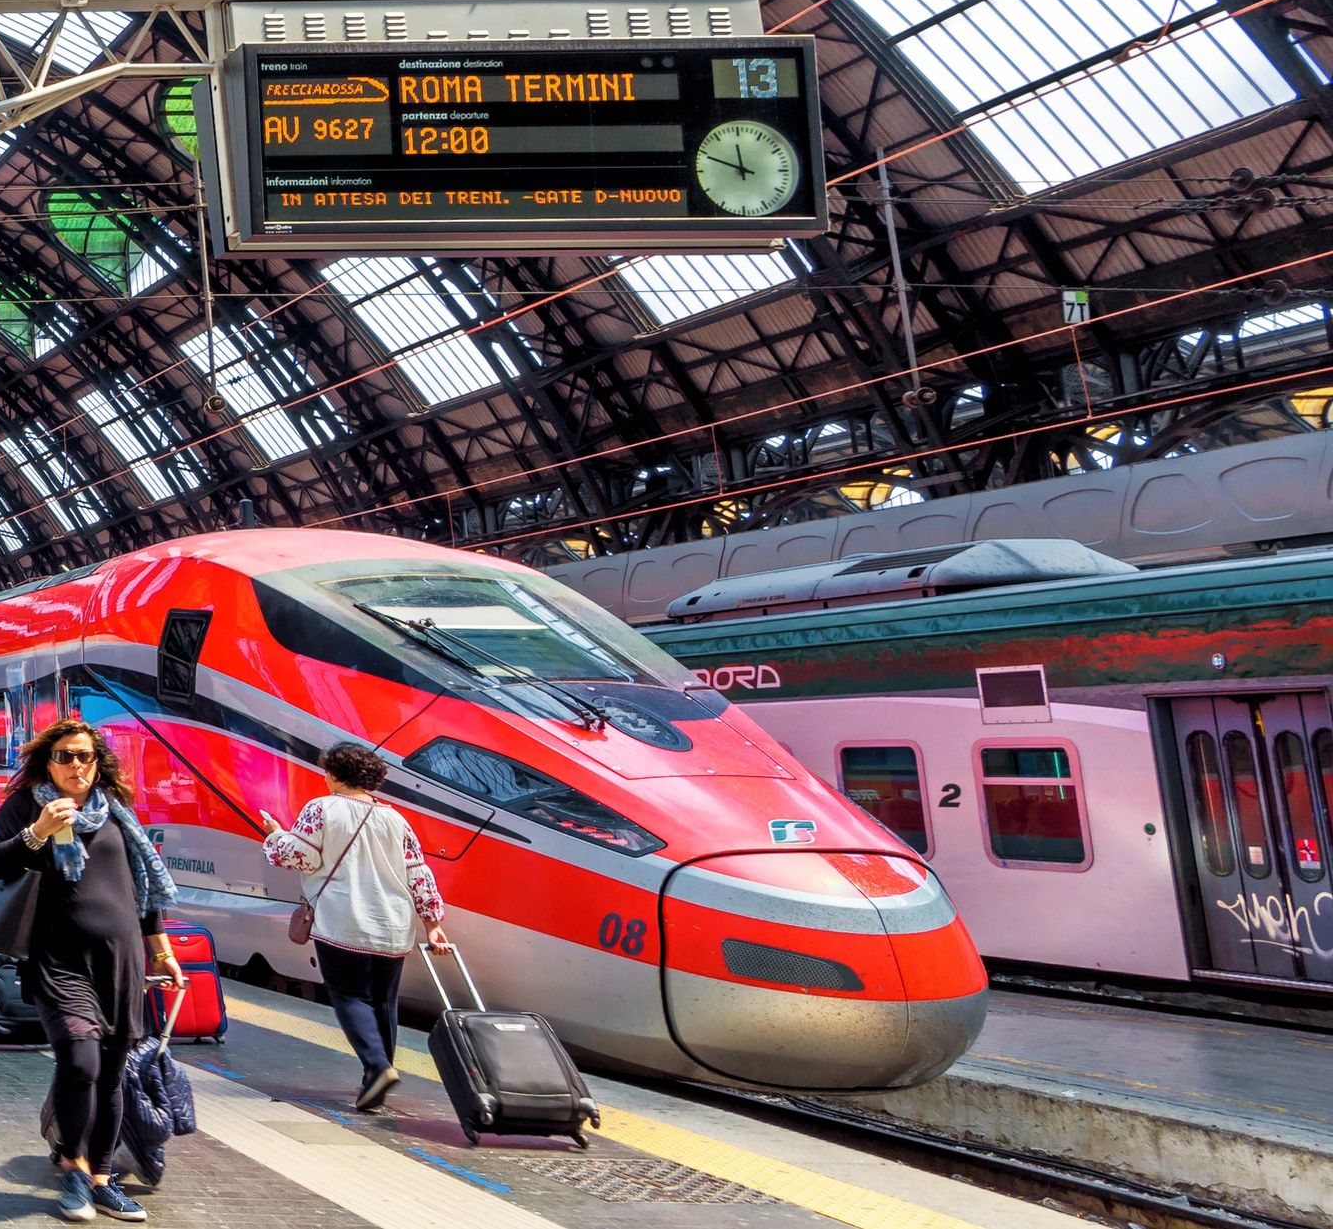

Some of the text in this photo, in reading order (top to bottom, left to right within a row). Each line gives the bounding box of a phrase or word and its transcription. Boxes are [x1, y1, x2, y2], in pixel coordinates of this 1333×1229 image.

[261, 62, 308, 71] treno train
[399, 59, 503, 69] destinazione destination
[732, 58, 779, 98] 13
[266, 83, 363, 96] FRECCIAROSSA
[399, 73, 636, 104] ROMA TERMINI
[402, 110, 489, 122] partenza departure
[264, 116, 374, 144] AV 9627
[404, 126, 489, 155] 12:00
[266, 176, 372, 187] informazioni information
[281, 193, 302, 206] IN
[313, 192, 387, 206] ATTESA
[399, 192, 432, 205] DEI
[445, 191, 510, 205] TRENI.
[596, 189, 681, 204] D-NUOVO
[938, 783, 962, 808] 2
[166, 856, 216, 874] TRENITALIA
[598, 912, 647, 956] 08
